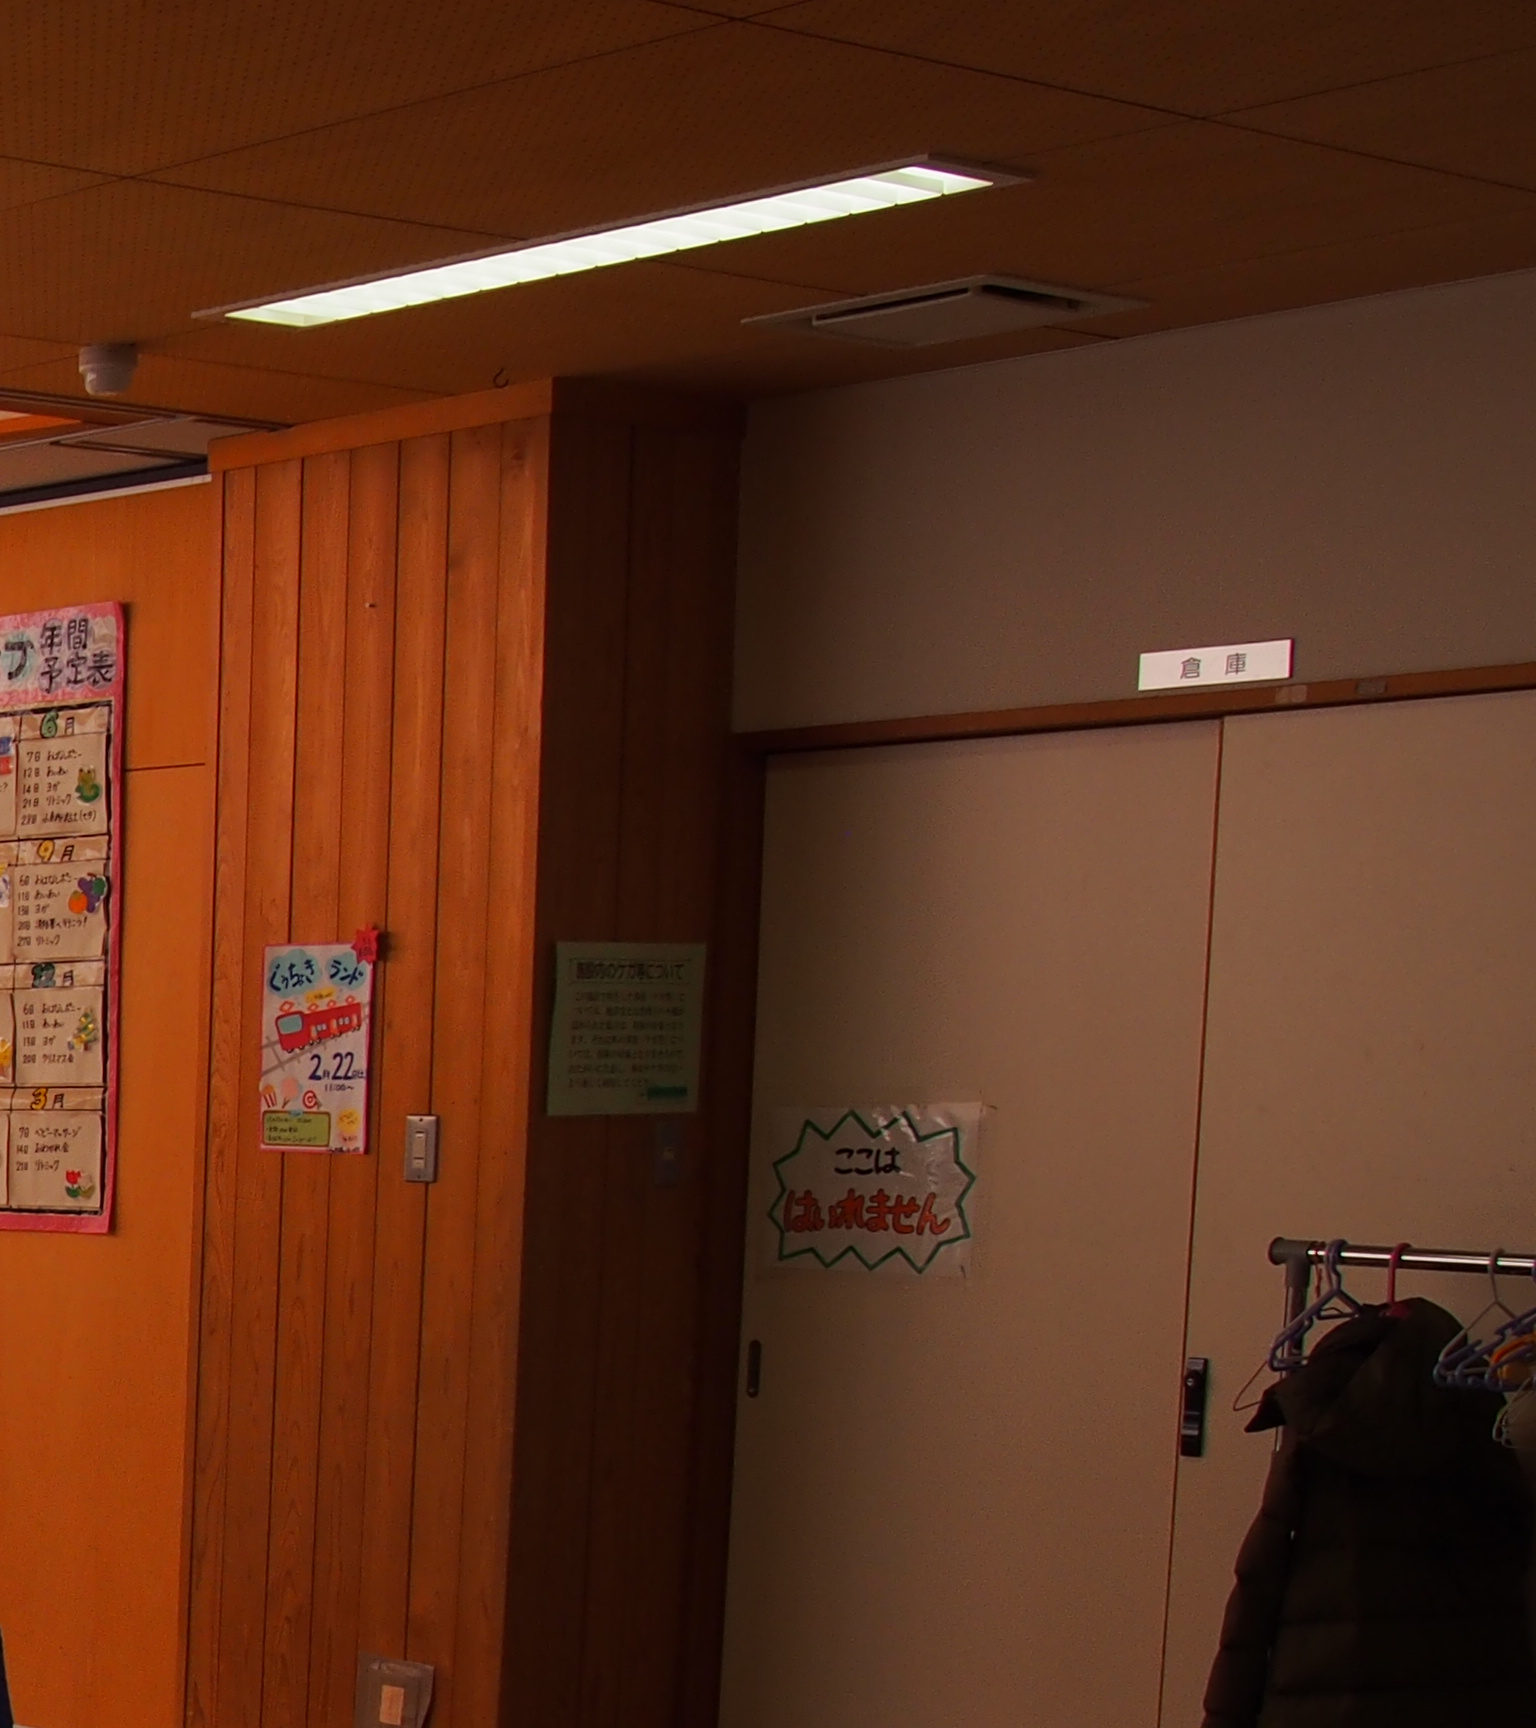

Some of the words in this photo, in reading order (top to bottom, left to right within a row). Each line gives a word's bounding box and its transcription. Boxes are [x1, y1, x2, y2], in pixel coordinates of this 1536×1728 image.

[40, 618, 89, 655] 年間
[40, 651, 115, 694] 予定表
[1180, 653, 1247, 679] 倉庫
[329, 959, 364, 985] ランド
[834, 1148, 901, 1174] ここは
[783, 1188, 951, 1236] はいれません
